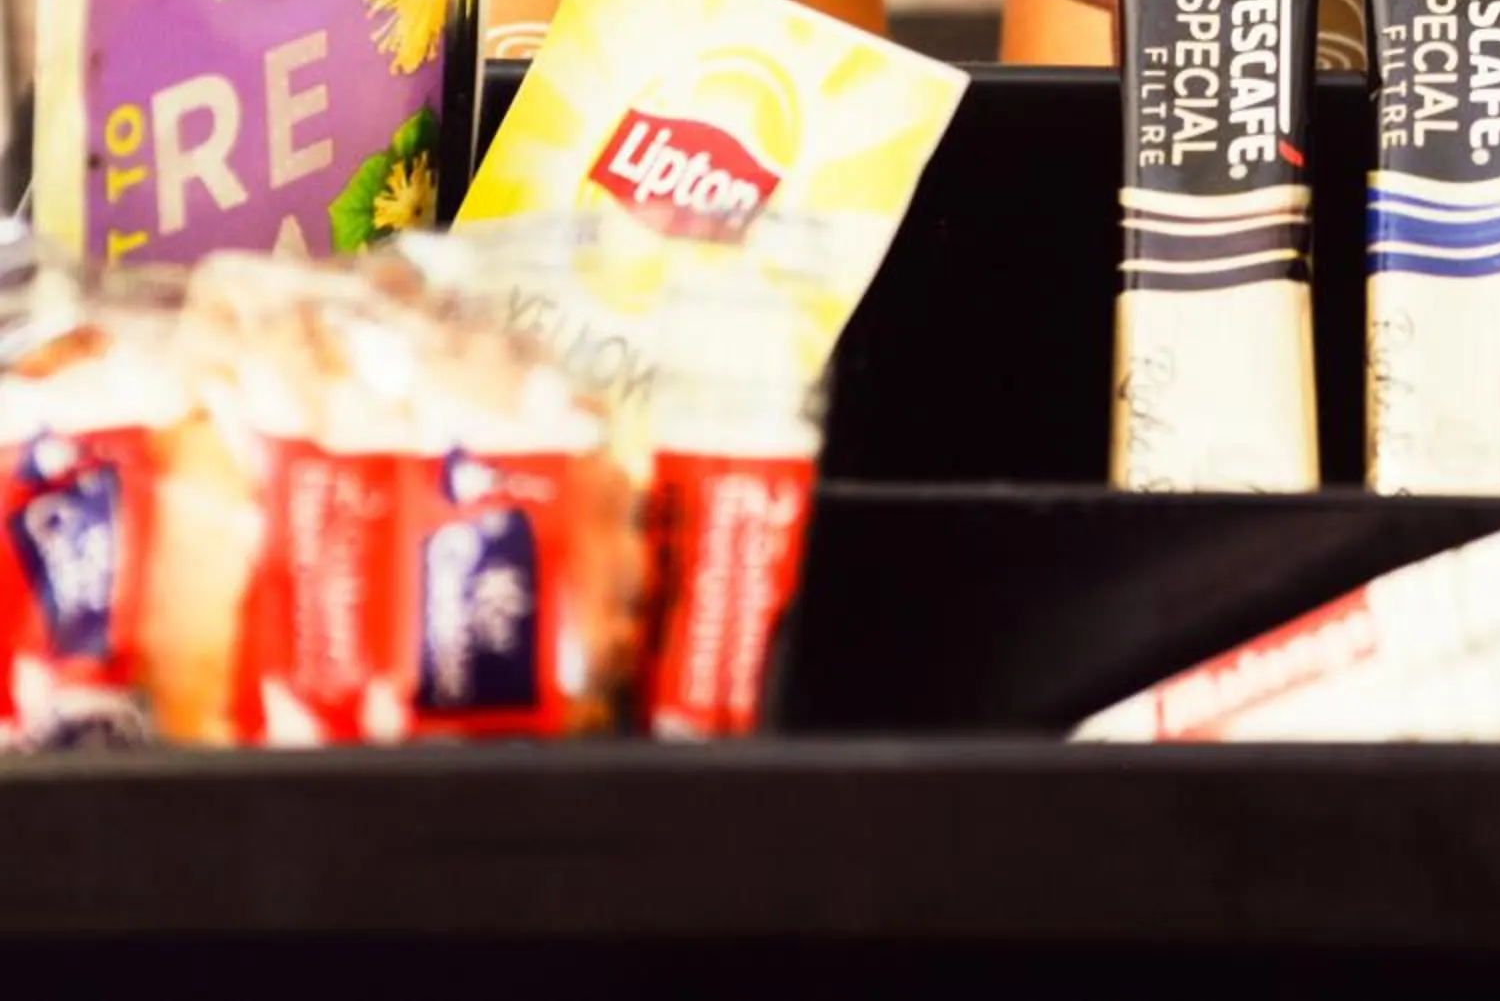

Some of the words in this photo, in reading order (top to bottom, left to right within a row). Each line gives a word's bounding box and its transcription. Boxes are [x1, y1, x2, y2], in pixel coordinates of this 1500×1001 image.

[150, 29, 334, 236] RE
[1138, 45, 1169, 168] FILTRE
[1380, 24, 1408, 150] FILTRE
[608, 119, 761, 228] Lipton
